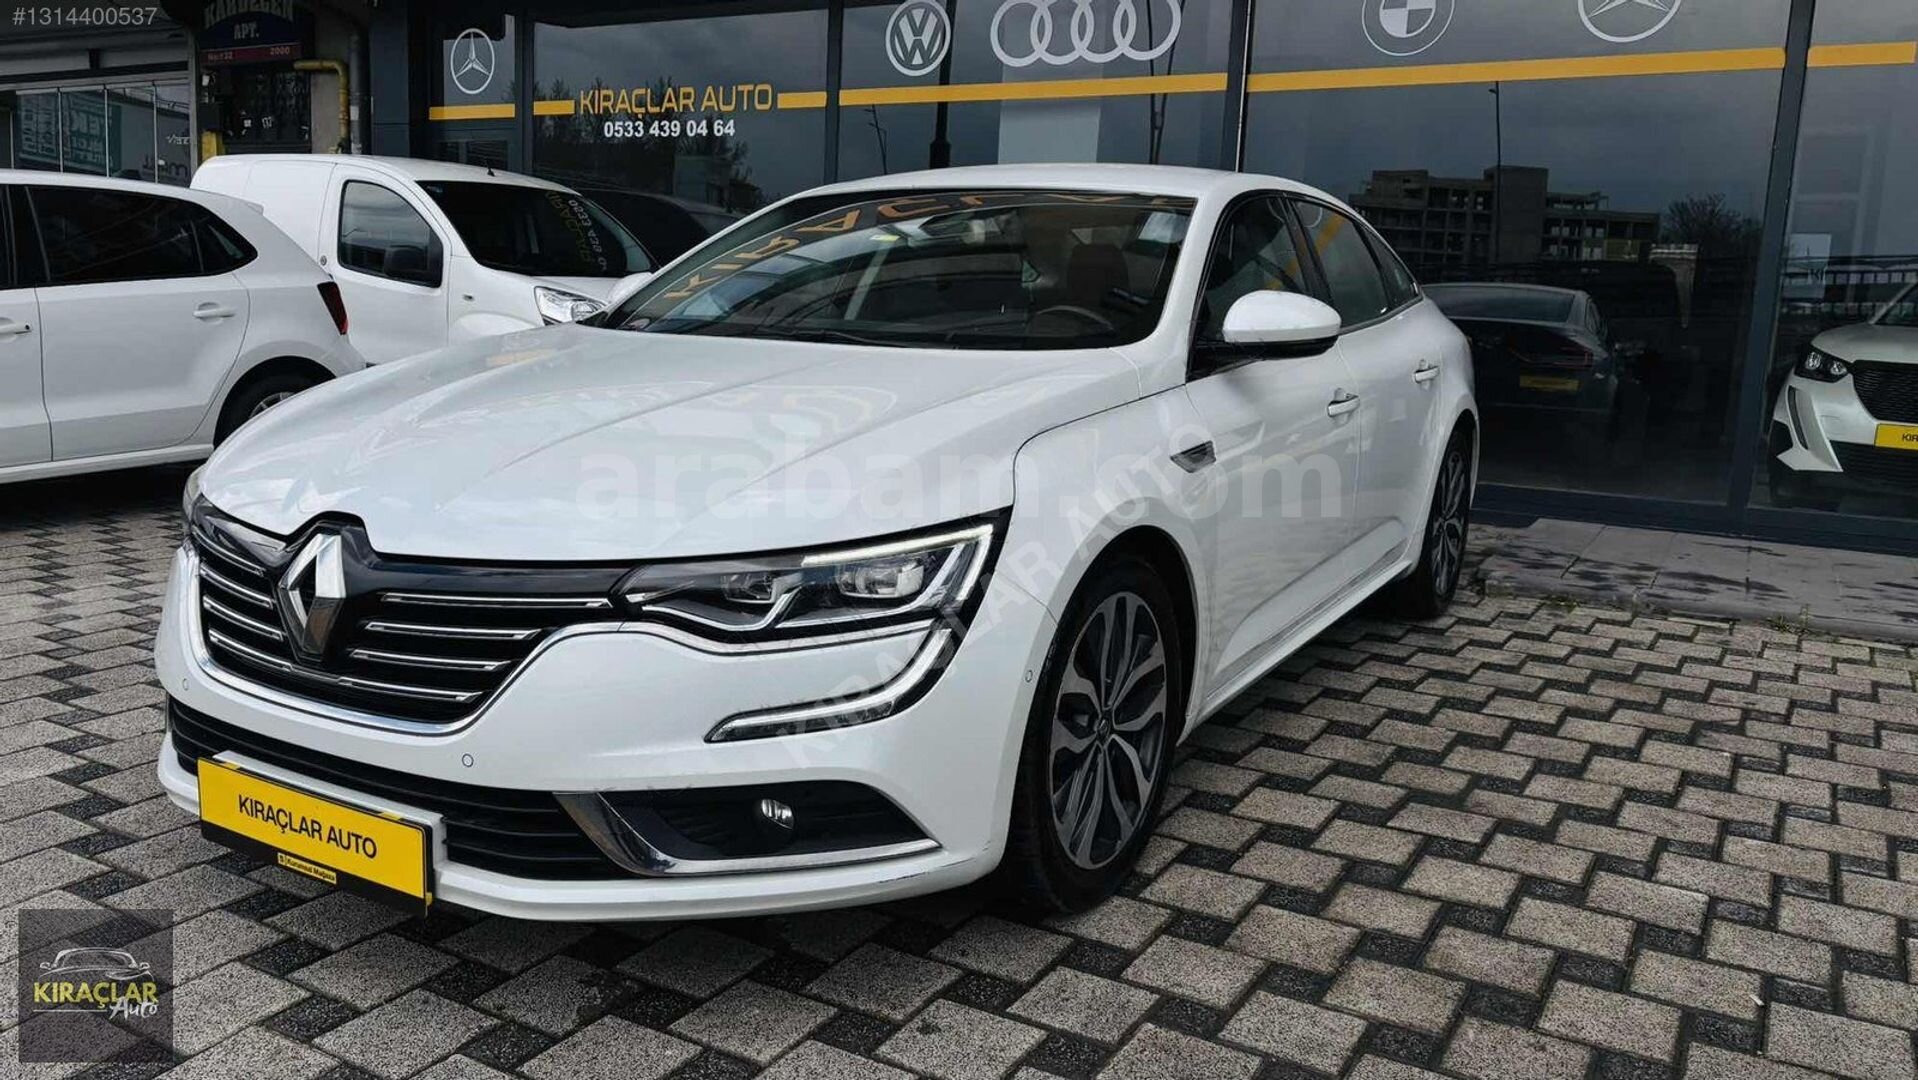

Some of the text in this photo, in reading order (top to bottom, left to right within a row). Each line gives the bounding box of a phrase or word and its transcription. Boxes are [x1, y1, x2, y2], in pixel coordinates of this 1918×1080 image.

[580, 83, 772, 118] KIRAÇLAR AUTO
[603, 119, 735, 138] 0533 439 04 64
[239, 794, 378, 859] KIRAÇLAR AUTO
